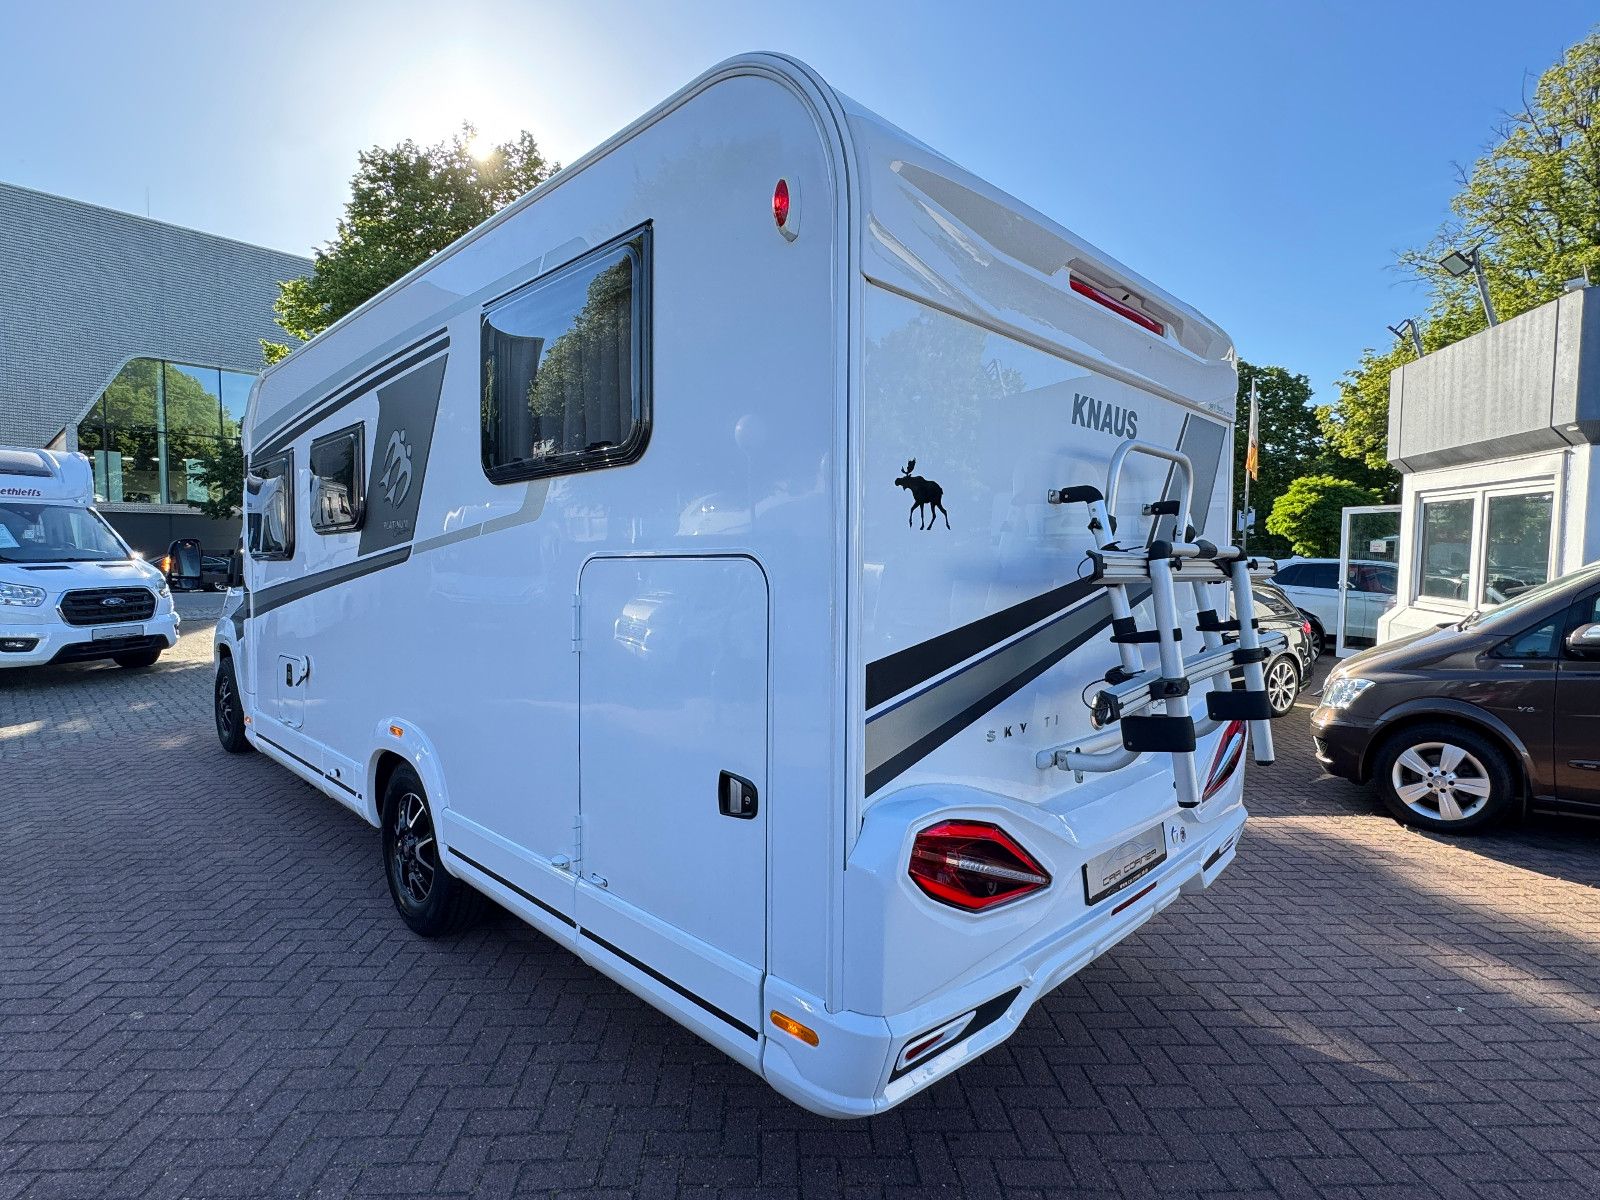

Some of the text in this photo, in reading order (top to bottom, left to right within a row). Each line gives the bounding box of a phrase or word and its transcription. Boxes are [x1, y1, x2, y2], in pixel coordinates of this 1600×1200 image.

[1072, 393, 1138, 440] KNAUS
[986, 714, 1059, 743] SKY TI
[1102, 868, 1122, 887] CAR
[1123, 848, 1157, 874] CORNER
